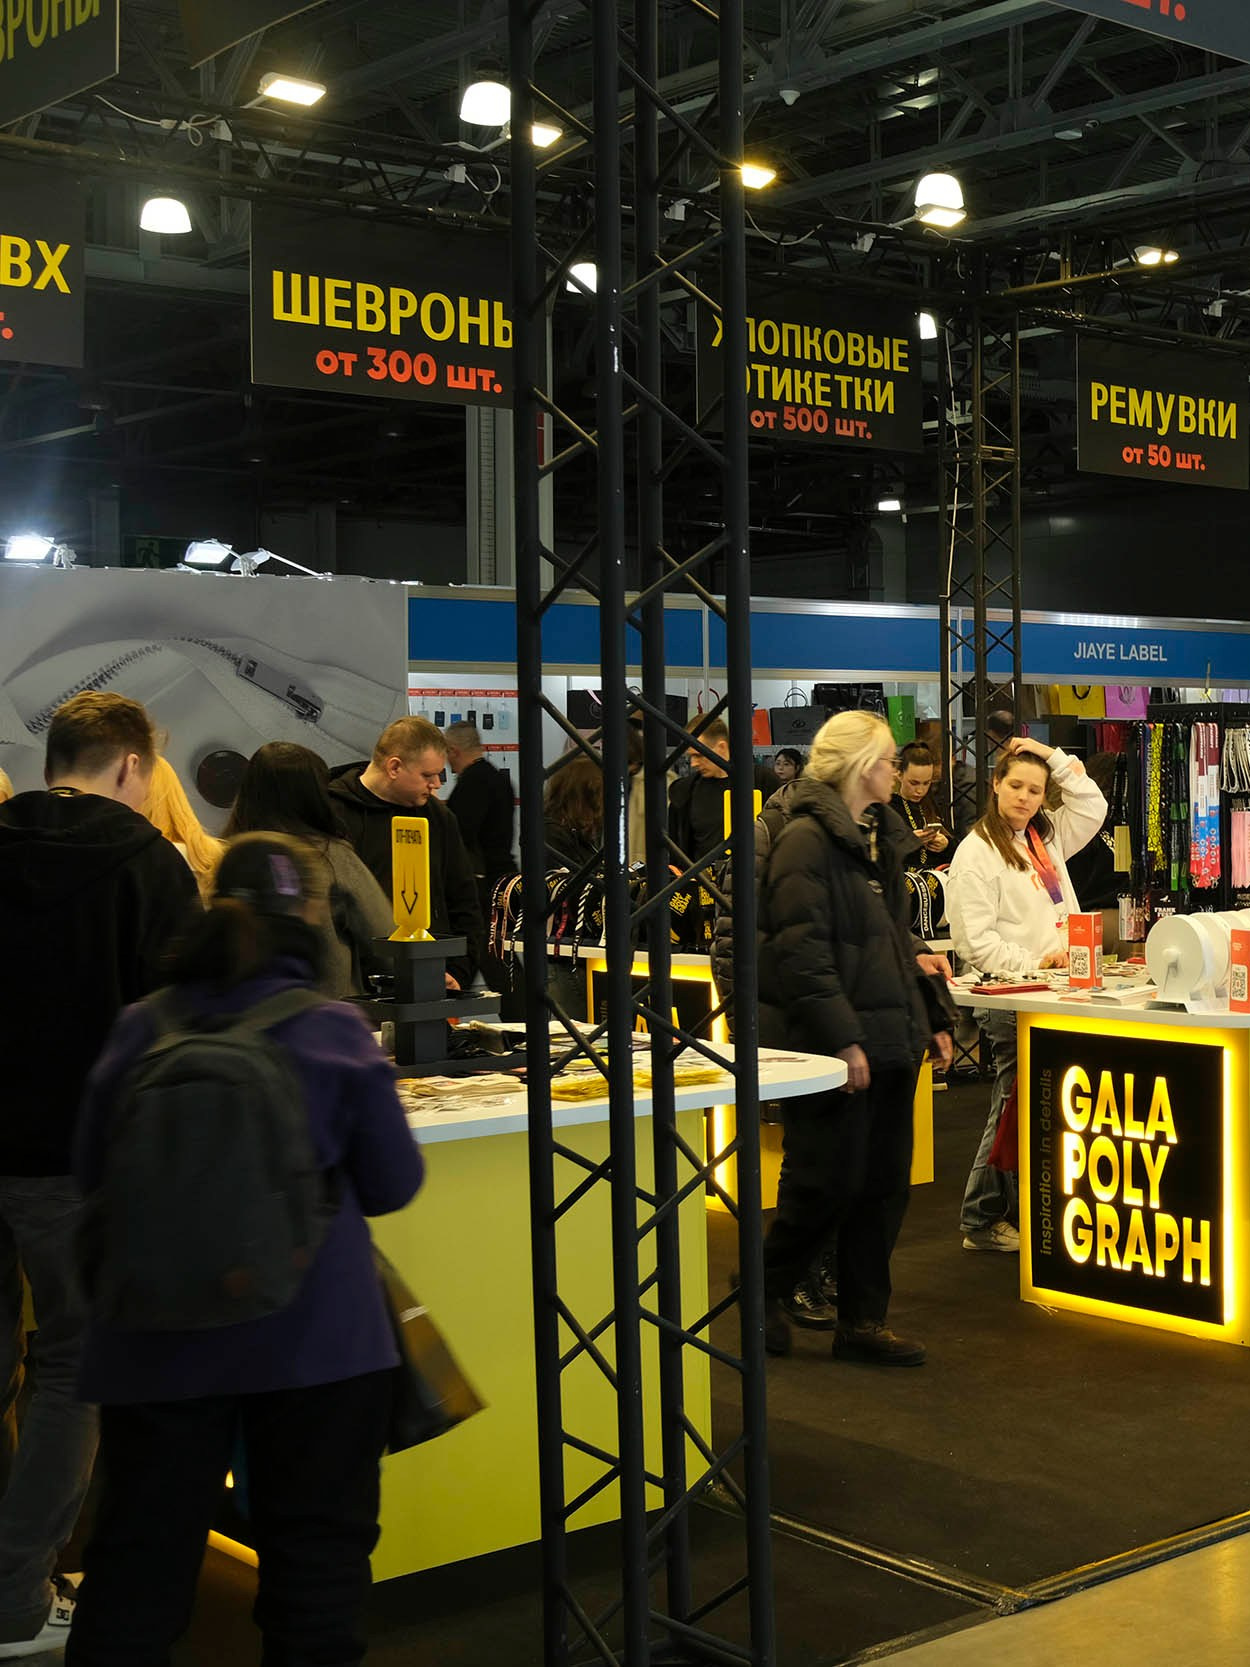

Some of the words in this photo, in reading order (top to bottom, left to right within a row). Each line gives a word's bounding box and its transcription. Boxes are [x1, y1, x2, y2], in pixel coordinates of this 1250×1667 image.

[316, 350, 358, 376] от
[367, 347, 437, 386] 300
[447, 365, 503, 393] шт.
[750, 410, 777, 430] от
[783, 406, 829, 434] 500
[835, 417, 873, 440] шт.
[1091, 382, 1237, 440] РЕМУВКИ
[1122, 447, 1144, 465] от
[1147, 444, 1171, 468] 50
[1176, 452, 1206, 471] шт.
[1073, 642, 1115, 660] JIAYE
[1119, 643, 1168, 662] LABEL
[1040, 1069, 1052, 1129] details
[1062, 1065, 1178, 1144] GALA
[1040, 1136, 1052, 1153] in
[1063, 1132, 1170, 1209] POLY
[1040, 1160, 1052, 1256] inspiration
[1064, 1197, 1211, 1287] GRAPH
